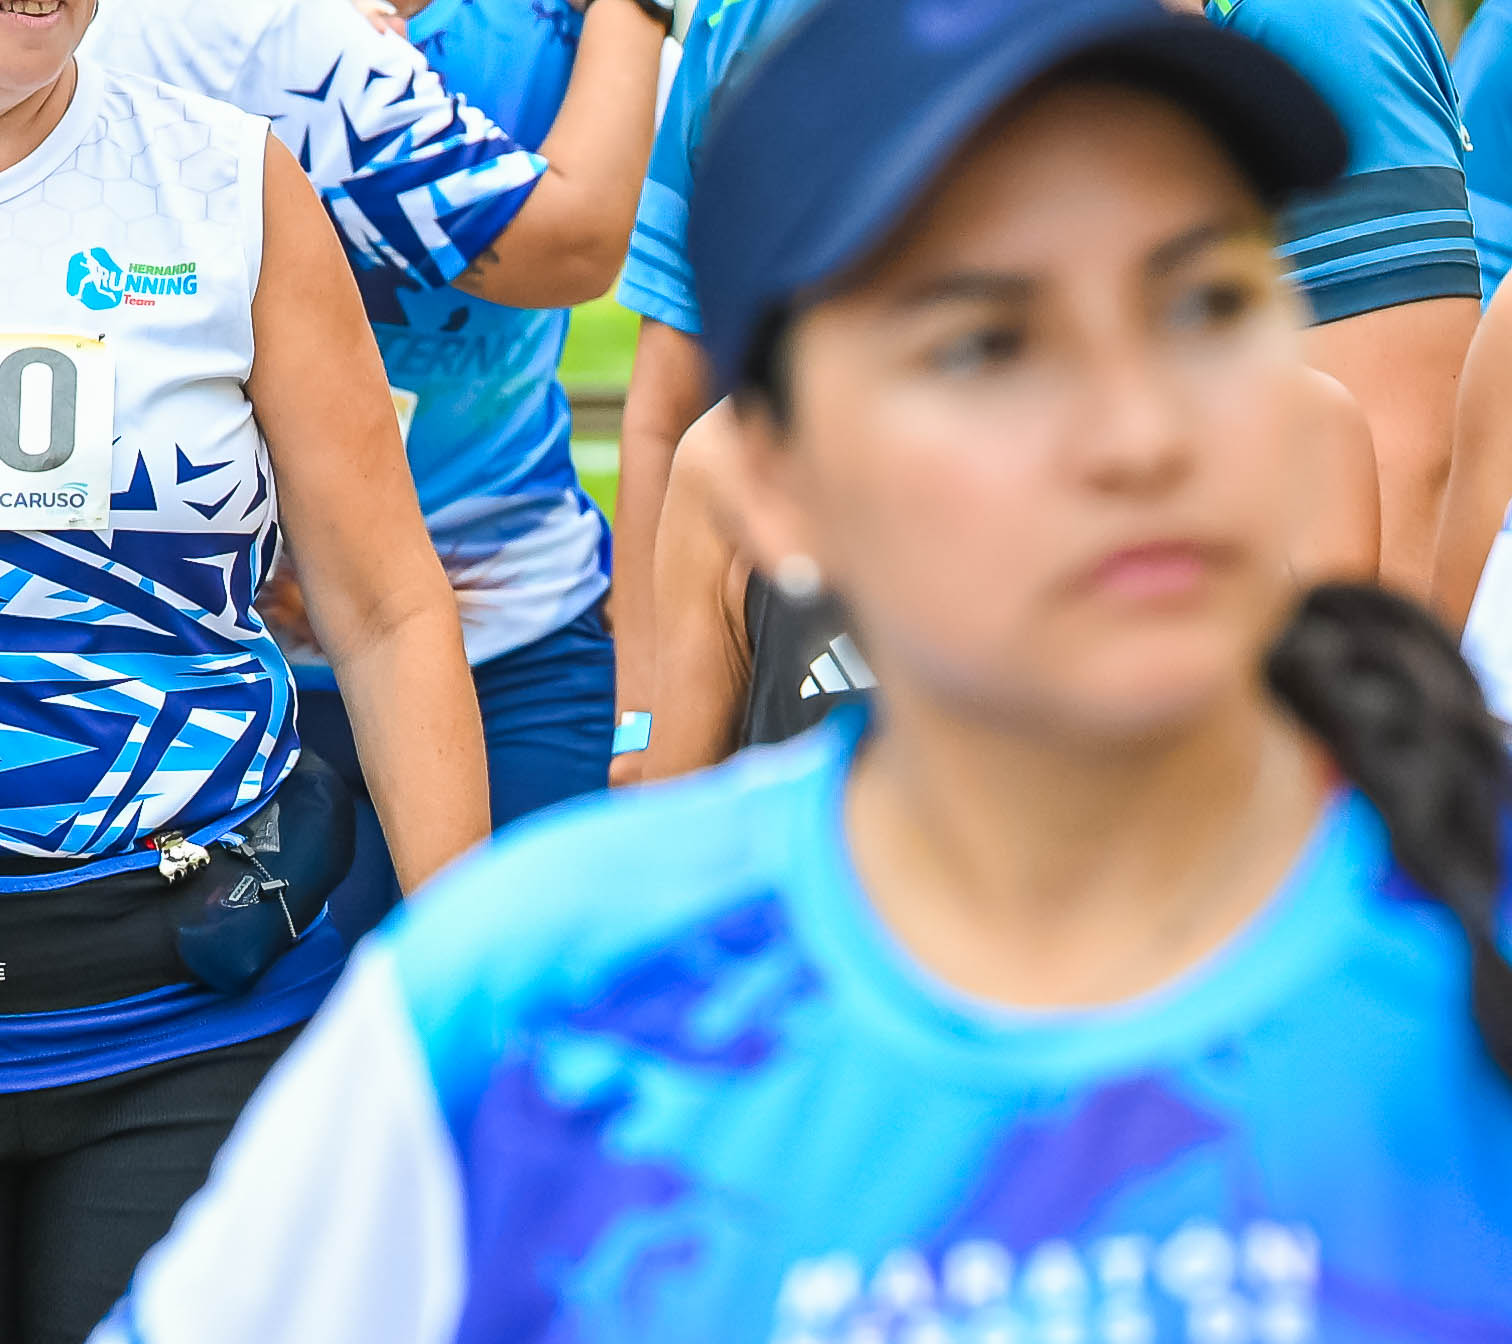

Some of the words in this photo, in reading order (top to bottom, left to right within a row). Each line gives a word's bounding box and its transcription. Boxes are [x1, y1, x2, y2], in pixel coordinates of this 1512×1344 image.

[129, 262, 196, 276] HERNANDO
[124, 294, 156, 306] Team
[0, 492, 86, 509] CARUSO
